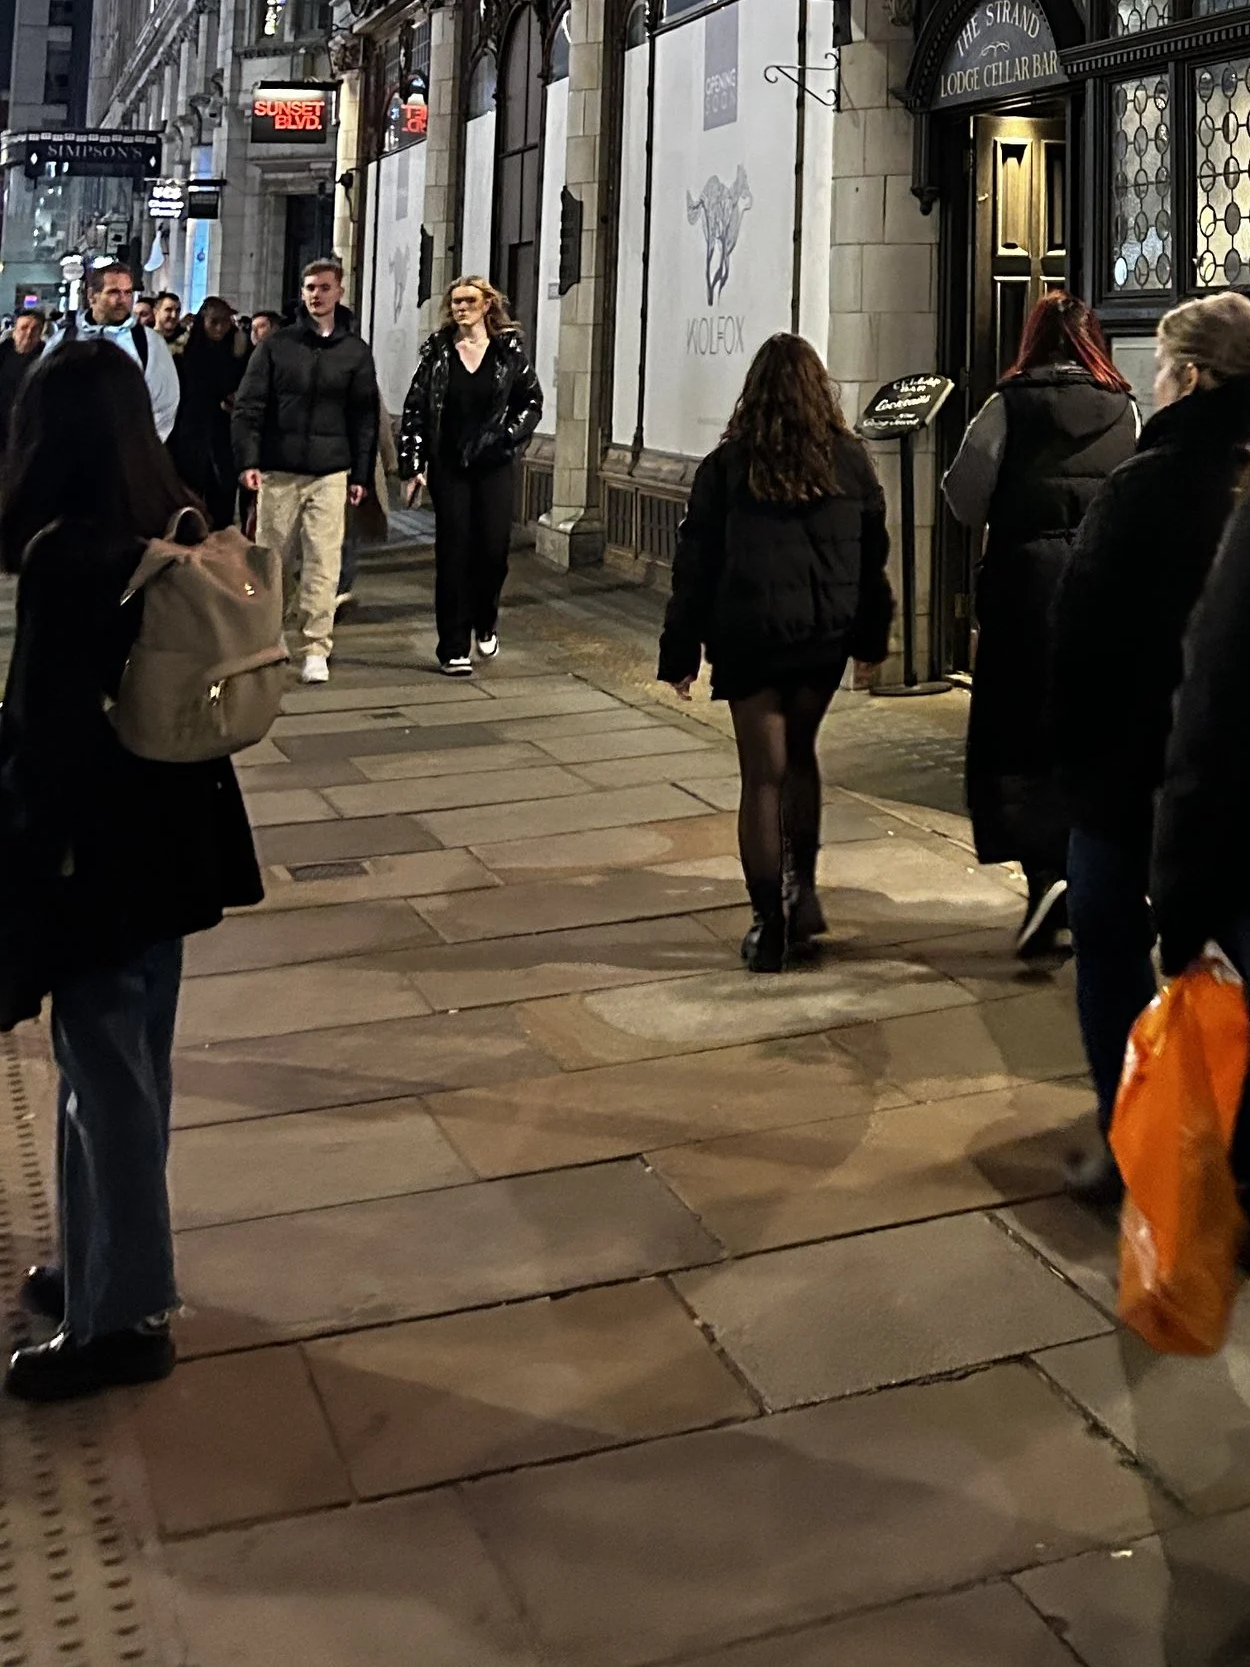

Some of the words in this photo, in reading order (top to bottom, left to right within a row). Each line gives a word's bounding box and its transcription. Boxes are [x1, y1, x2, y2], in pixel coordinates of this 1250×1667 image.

[954, 13, 981, 58] THE
[985, 0, 1041, 39] STRAND
[940, 66, 981, 98] LODGE
[983, 56, 1031, 88] CELLAR
[1032, 49, 1059, 79] BAR
[254, 100, 326, 116] SUNSET
[274, 115, 322, 130] BLVD.
[47, 143, 144, 159] SIMPSON'S
